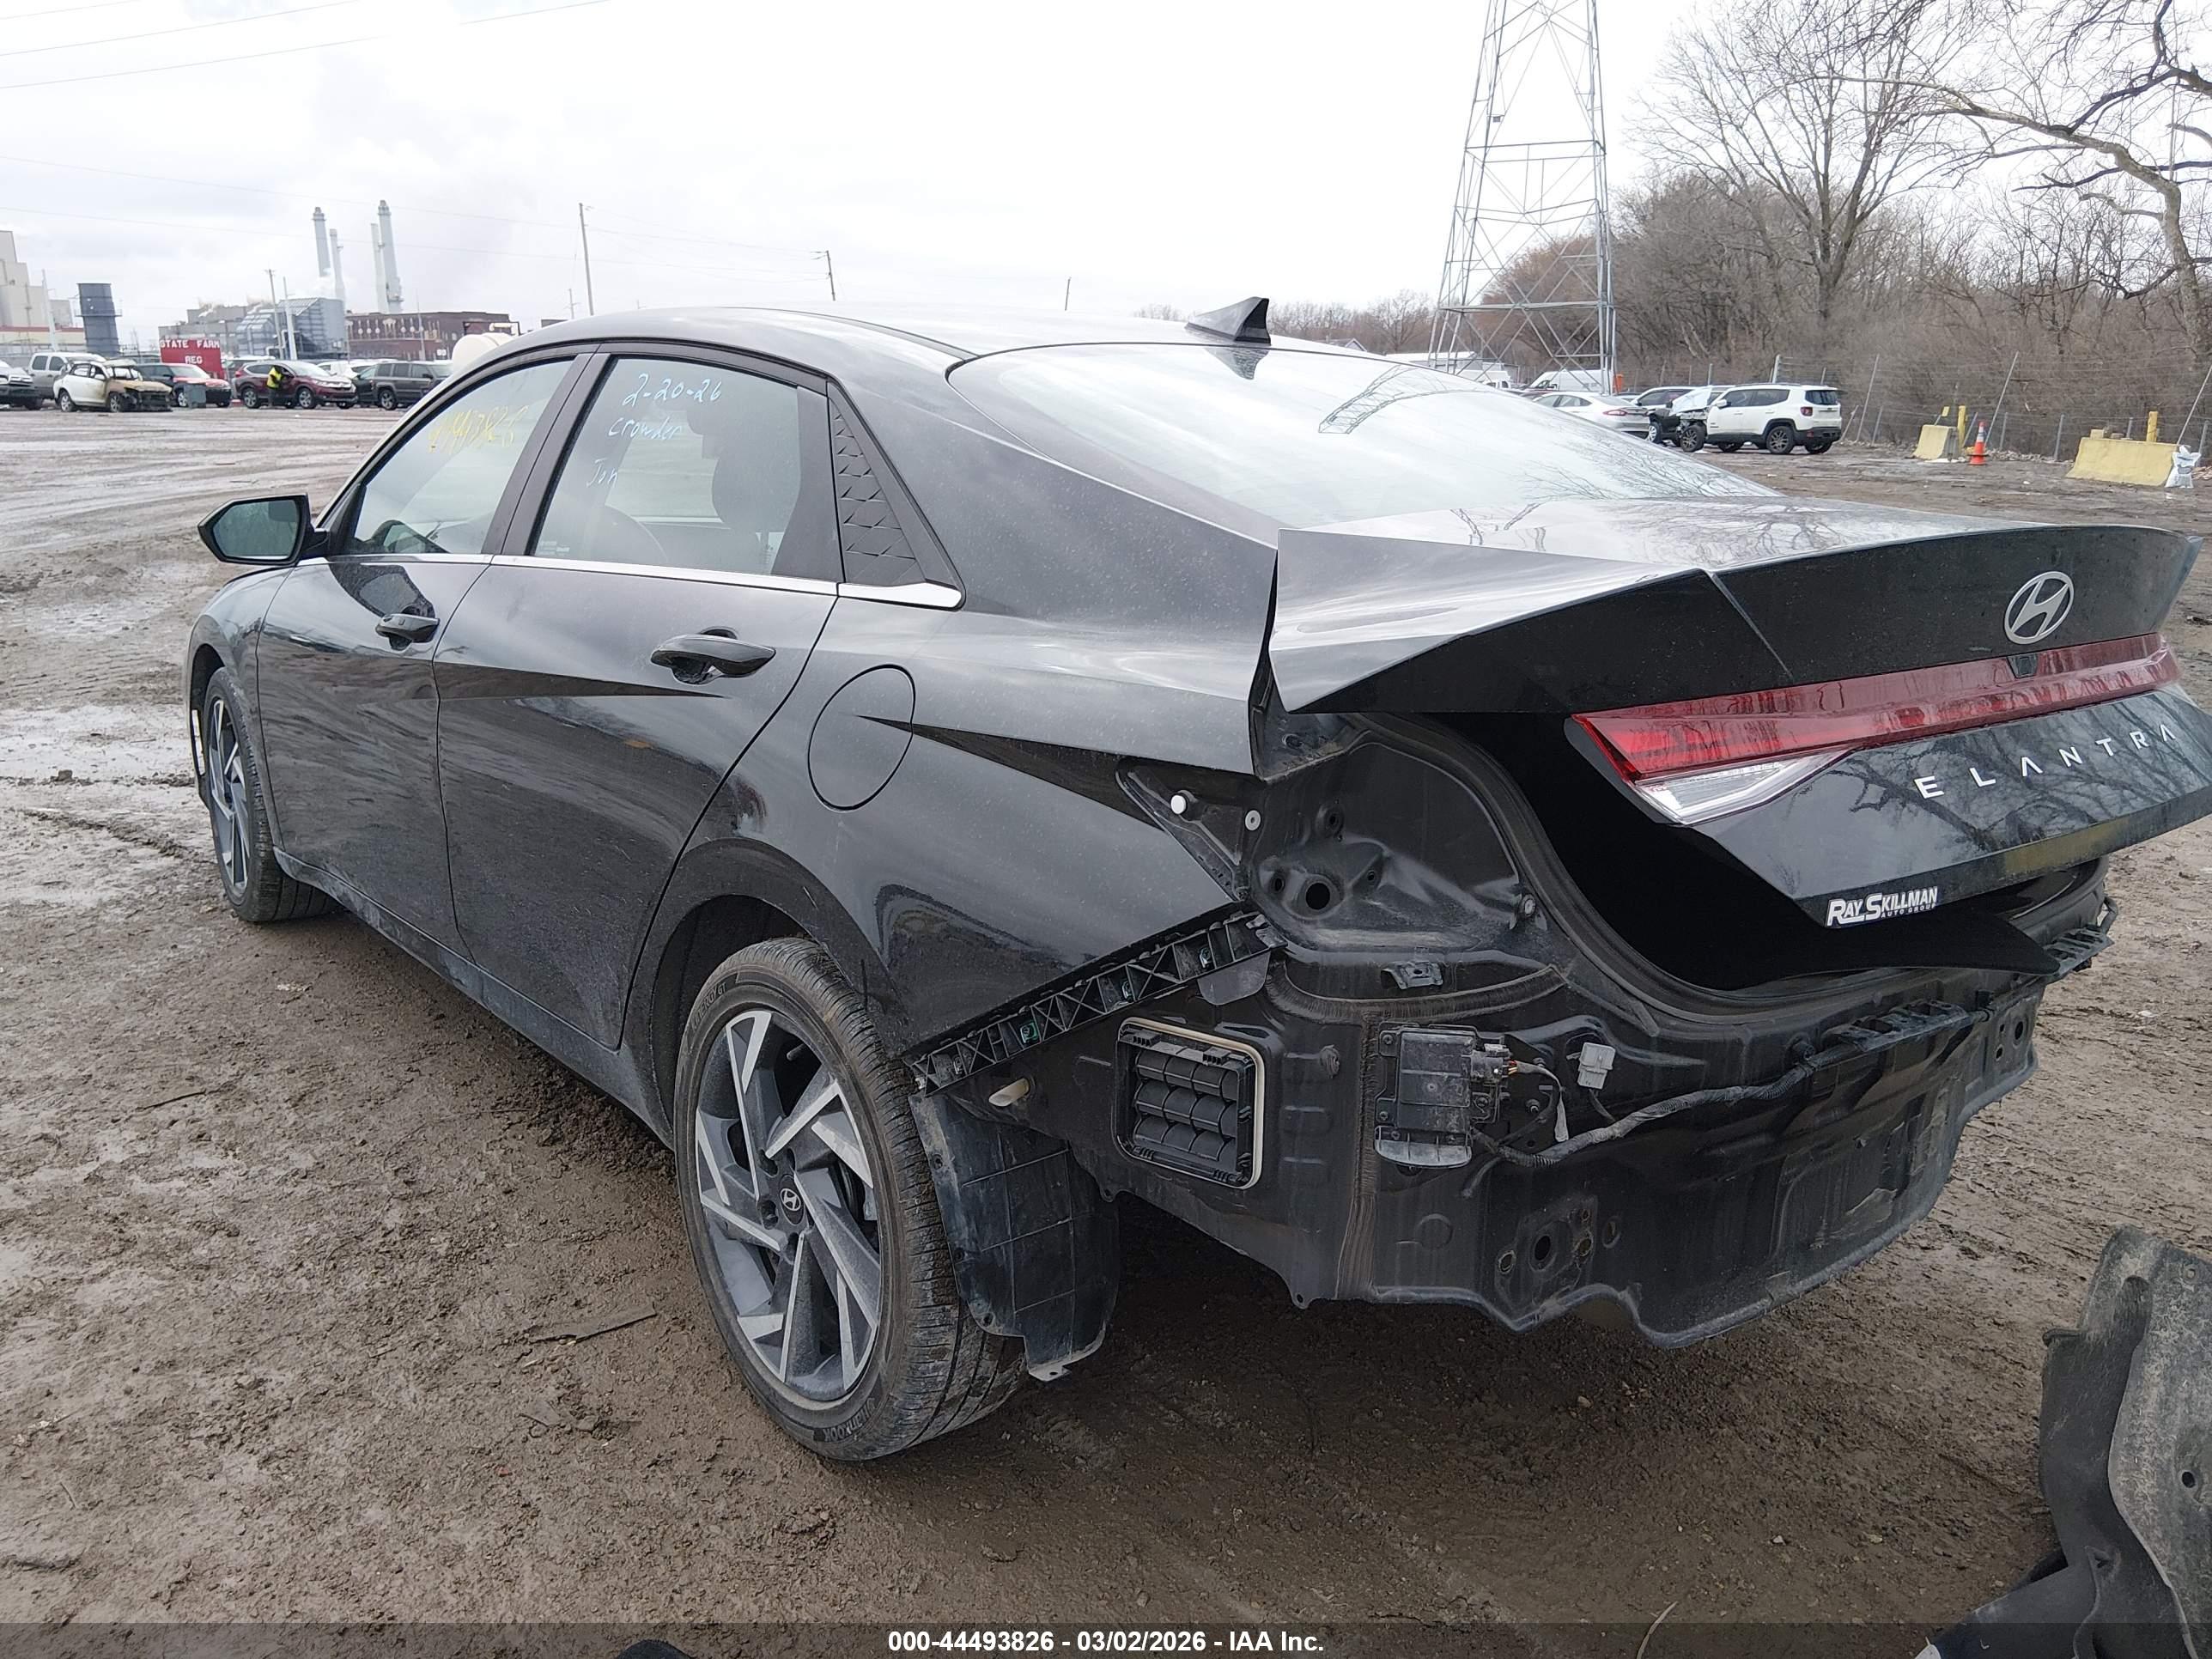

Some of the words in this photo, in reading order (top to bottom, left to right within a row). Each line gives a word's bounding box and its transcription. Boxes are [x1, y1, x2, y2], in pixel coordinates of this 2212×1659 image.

[160, 339, 189, 349] STATE
[197, 339, 220, 349] FARM
[622, 373, 722, 407] 2-20-26
[1913, 724, 2176, 799] ELANTRA
[1881, 908, 1905, 919] AUTO
[1908, 902, 1936, 913] GROUP
